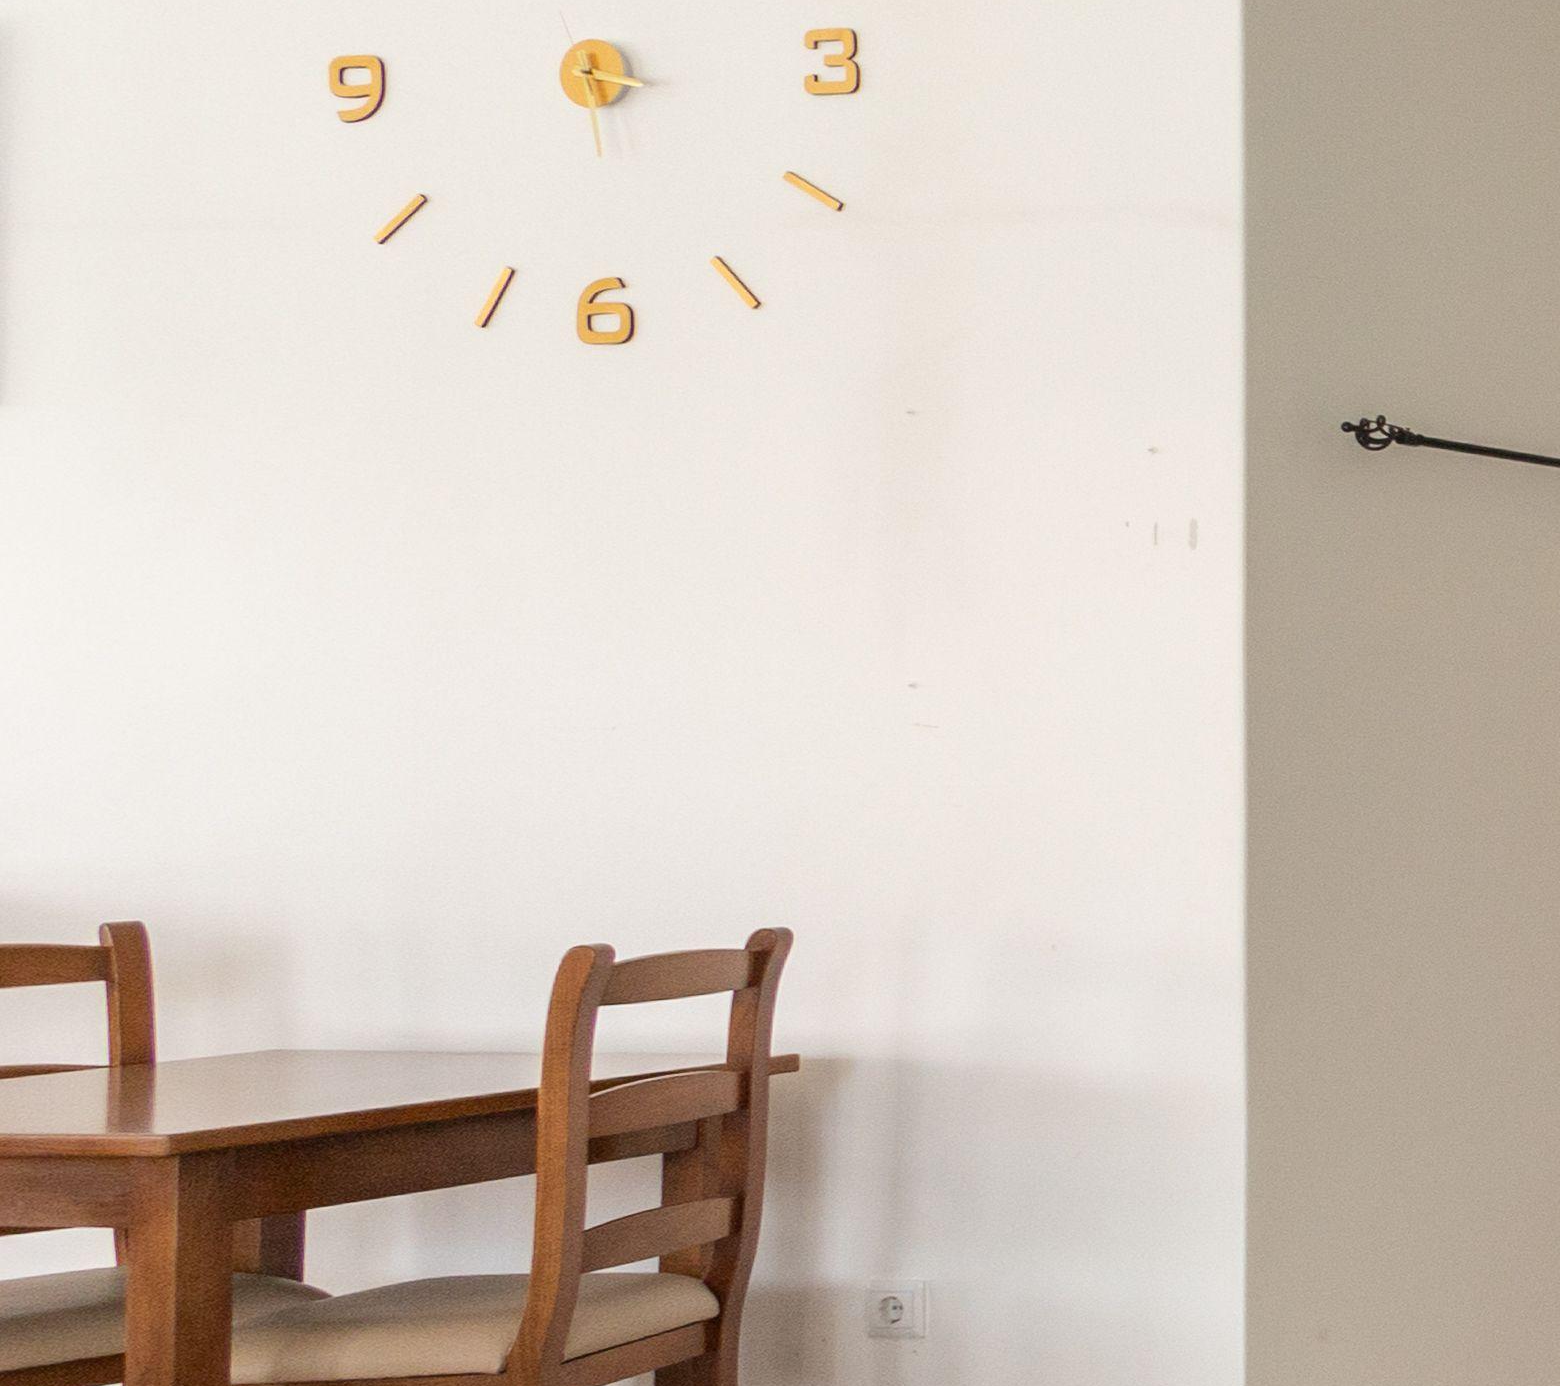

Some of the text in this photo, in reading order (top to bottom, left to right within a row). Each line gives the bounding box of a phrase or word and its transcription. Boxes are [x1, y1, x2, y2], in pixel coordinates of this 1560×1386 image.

[328, 55, 386, 123] 9
[803, 27, 861, 95] 3
[576, 277, 636, 345] 6
